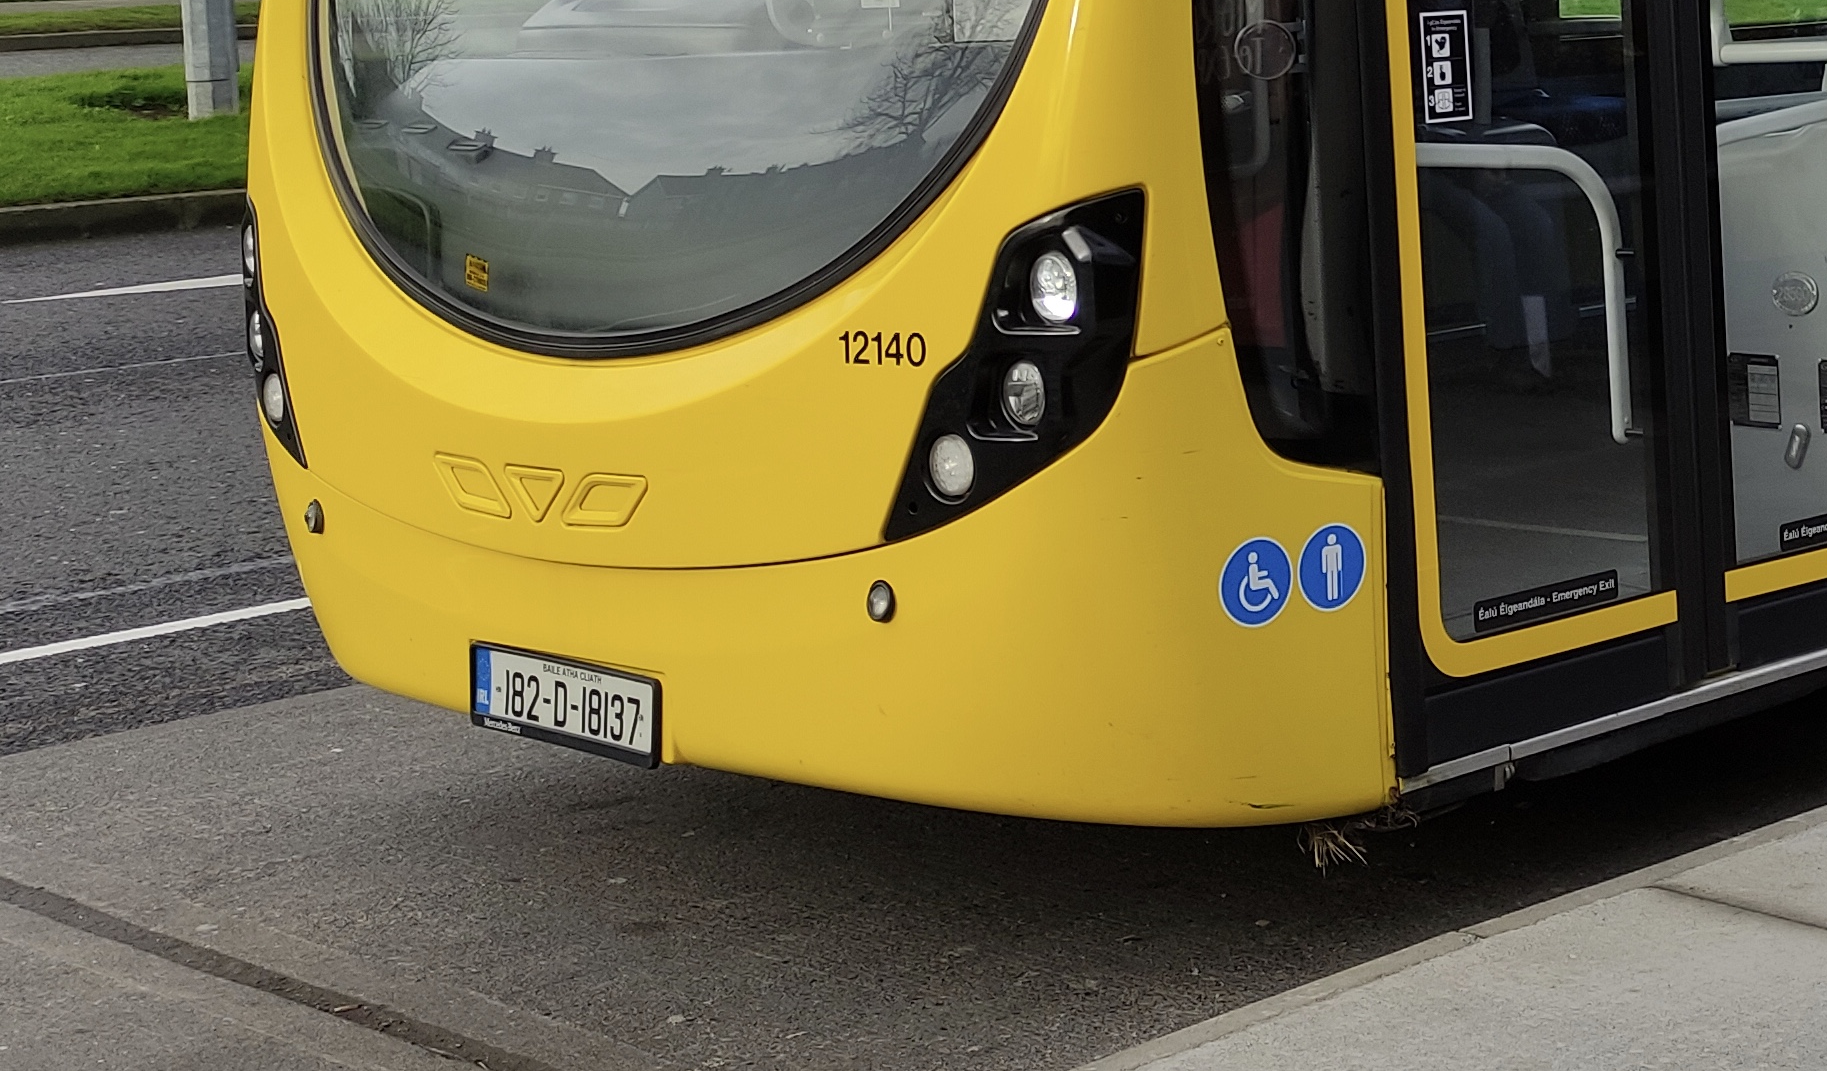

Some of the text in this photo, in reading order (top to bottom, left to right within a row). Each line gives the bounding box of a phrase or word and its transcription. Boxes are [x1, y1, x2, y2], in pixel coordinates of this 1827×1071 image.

[838, 330, 927, 368] 12140
[1552, 584, 1598, 604] Emergency
[1598, 578, 1616, 592] Exit
[542, 663, 561, 676] BAILE
[477, 688, 490, 705] IRL
[504, 669, 641, 746] 182-D-18137
